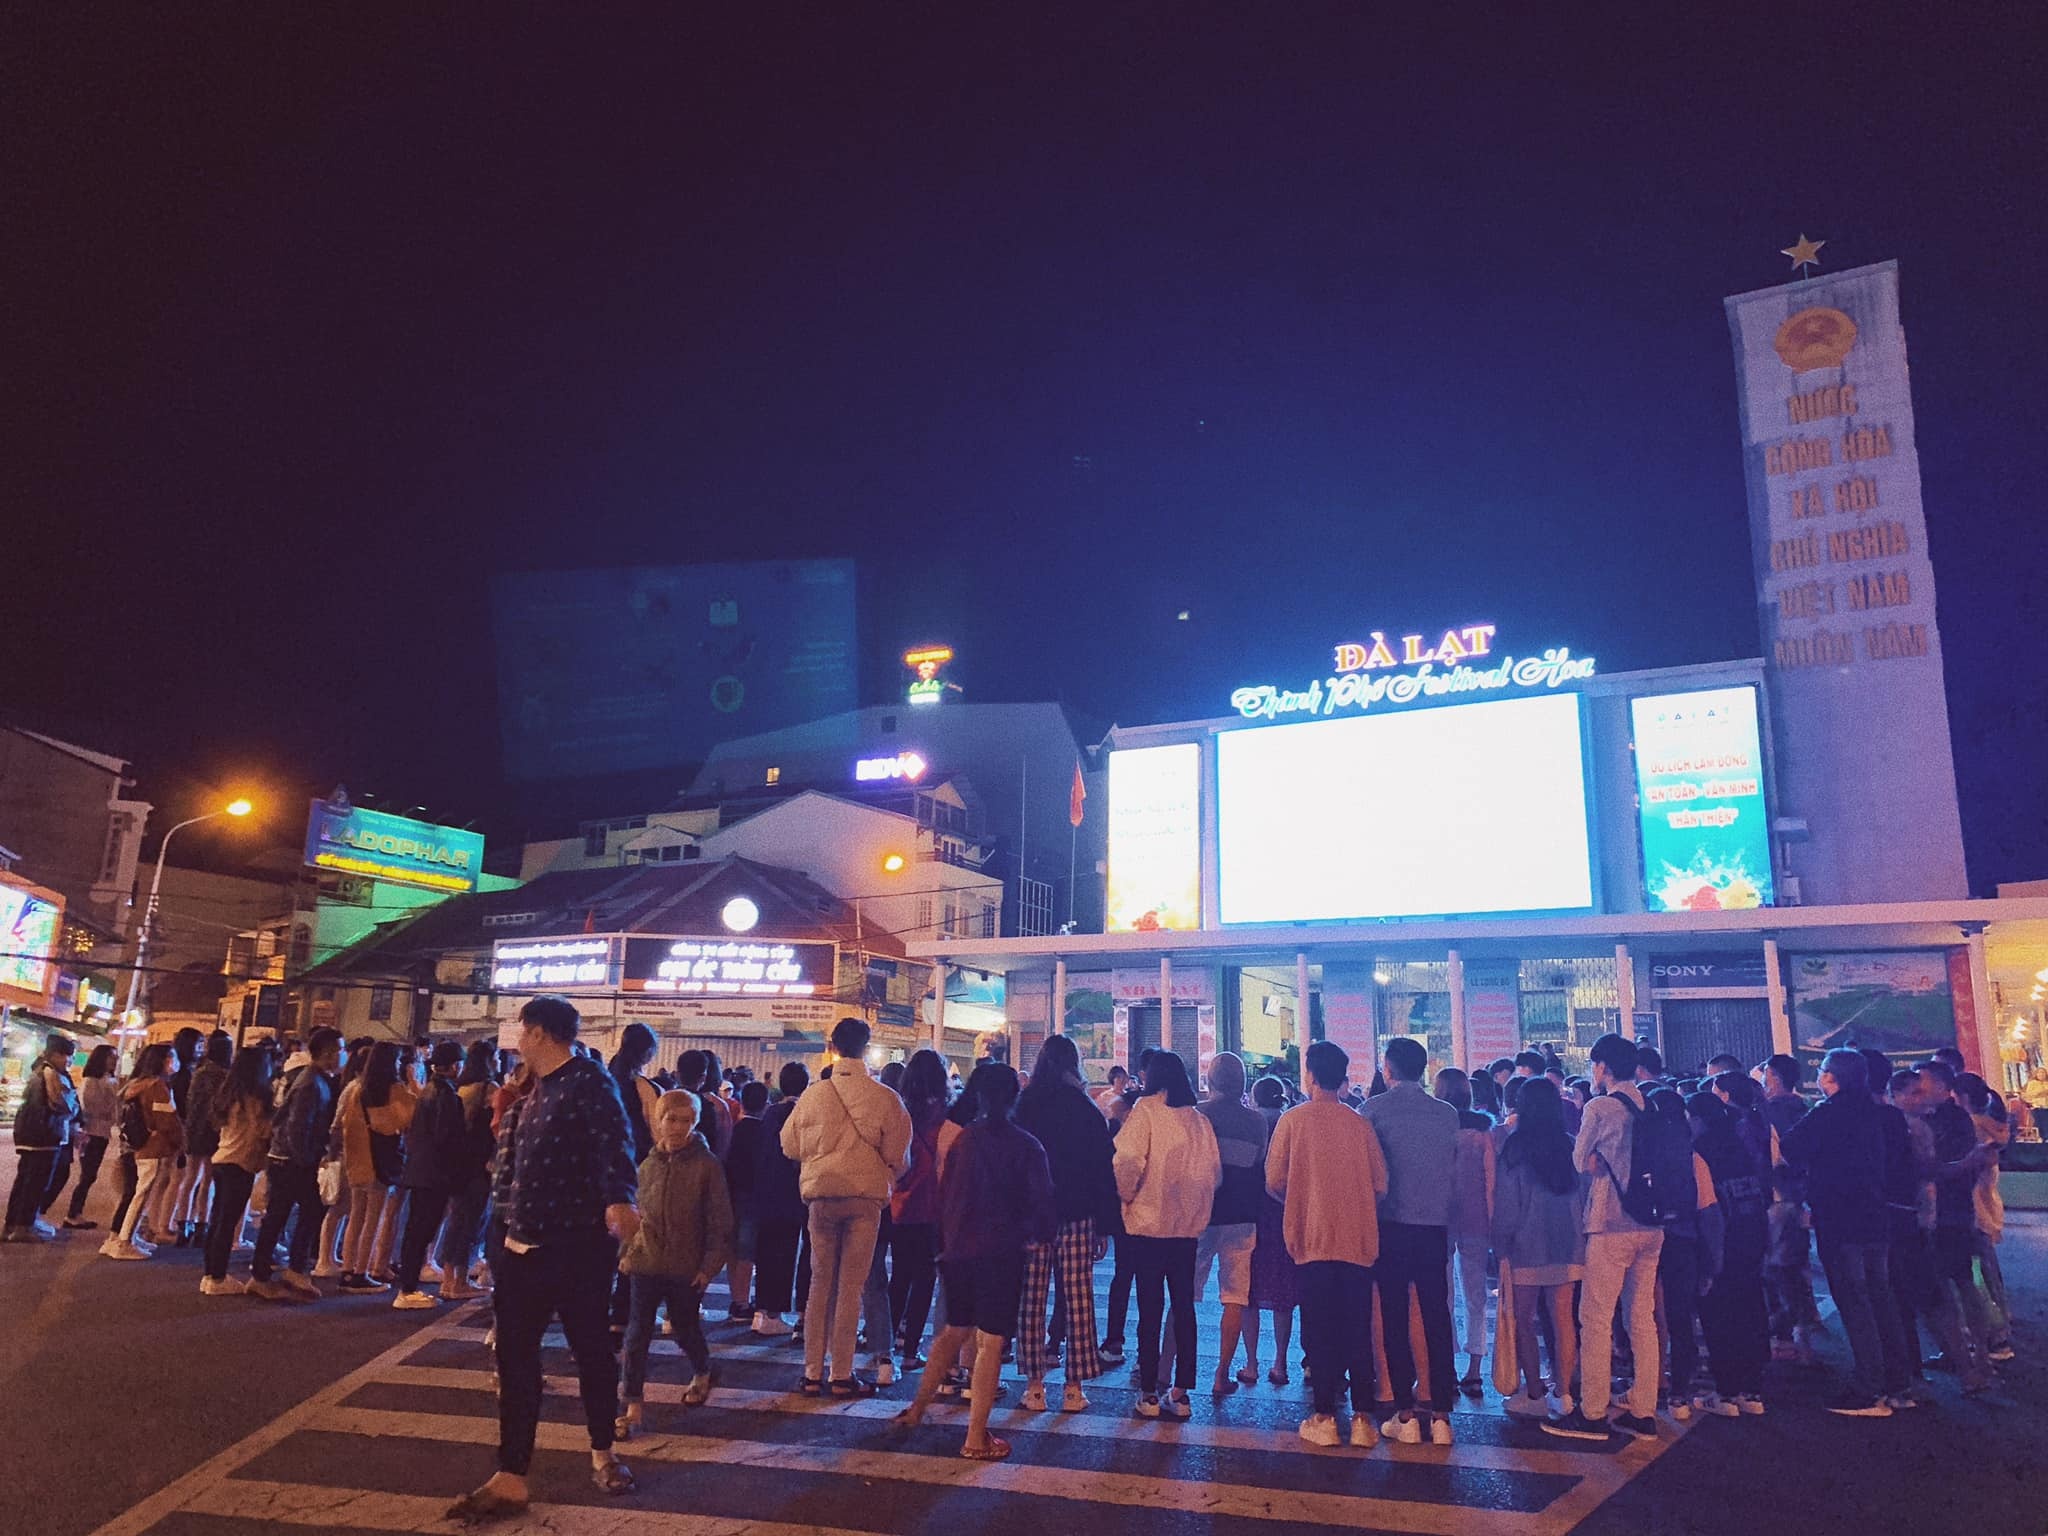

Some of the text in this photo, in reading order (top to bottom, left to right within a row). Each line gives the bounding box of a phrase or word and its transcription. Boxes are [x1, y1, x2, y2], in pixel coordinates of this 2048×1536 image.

[1848, 571, 1910, 611] NAM
[1334, 625, 1496, 673] ĐÀ LẠT
[1386, 663, 1514, 704] Festival
[1511, 646, 1596, 688] Hoa
[318, 822, 470, 869] LADOPHAR
[1653, 964, 1714, 977] SONY
